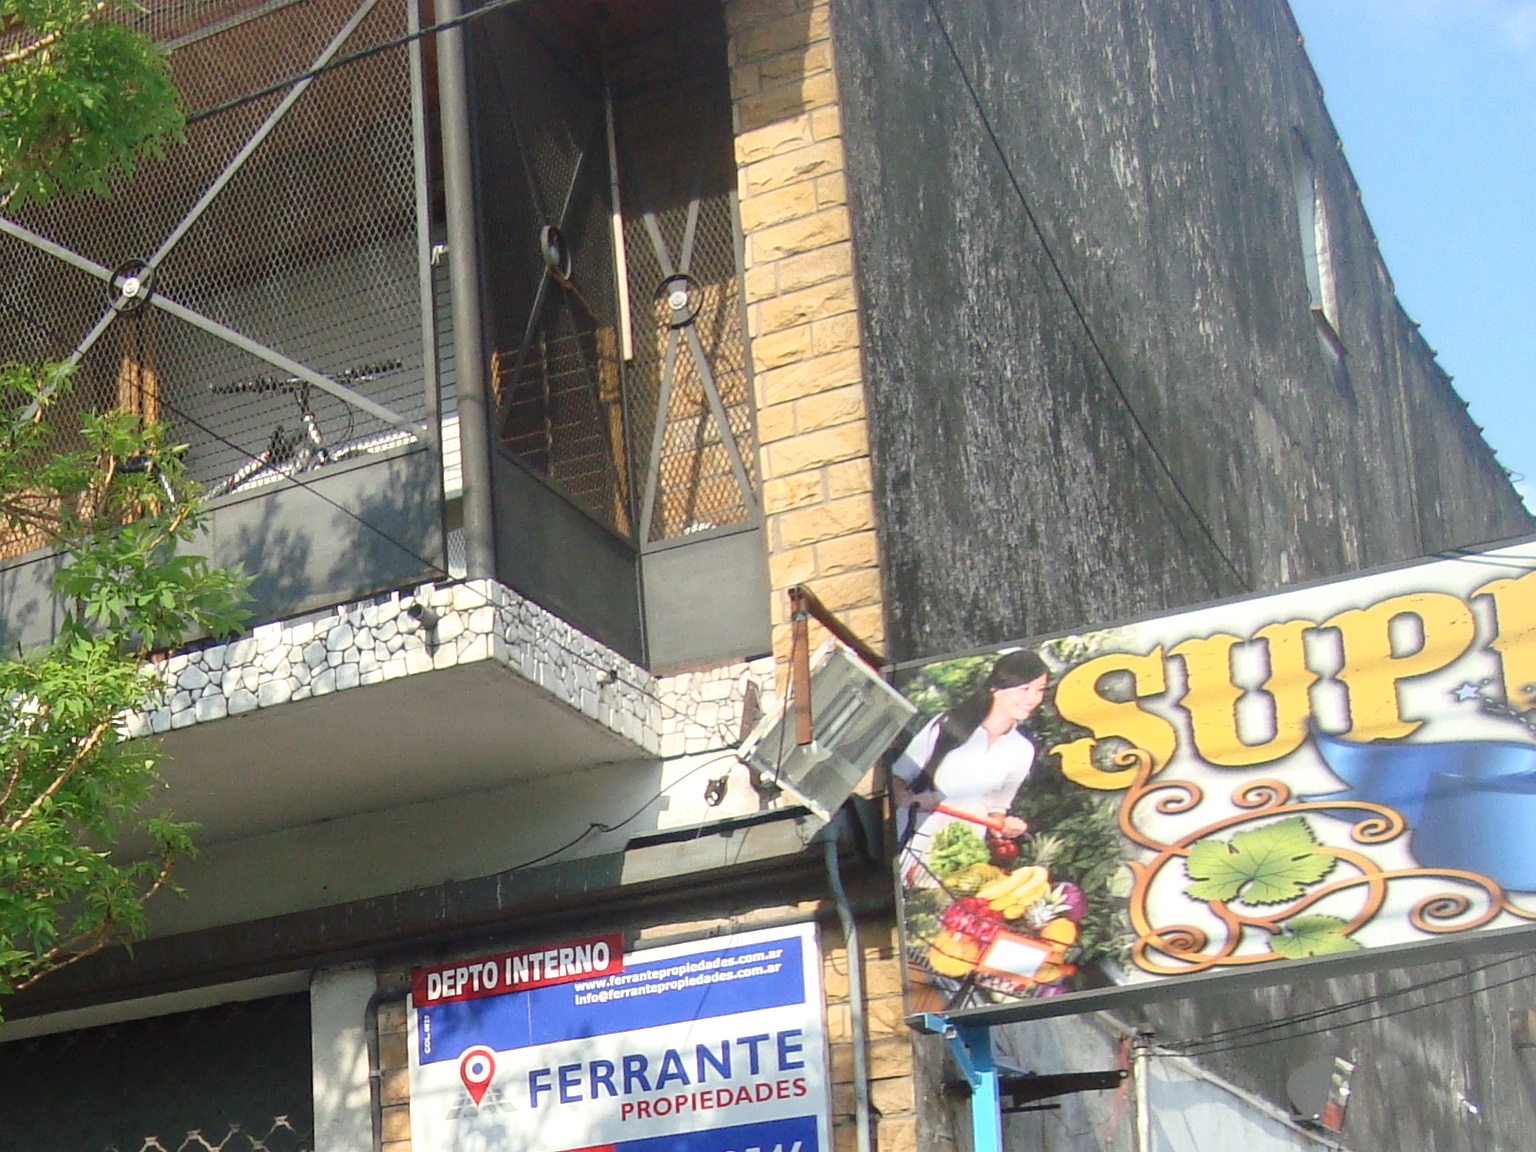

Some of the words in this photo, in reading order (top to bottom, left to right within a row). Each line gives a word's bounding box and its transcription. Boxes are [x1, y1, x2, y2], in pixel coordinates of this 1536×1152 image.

[427, 960, 498, 1001] DEPTO
[505, 941, 611, 986] INTERNO
[574, 949, 783, 991] www.ferrantepropiedades.com.ar
[575, 962, 782, 1005] info@ferrantepropiedades.com.ar
[528, 1028, 806, 1109] FERRANTE
[621, 1077, 807, 1122] PROPIEDADES
